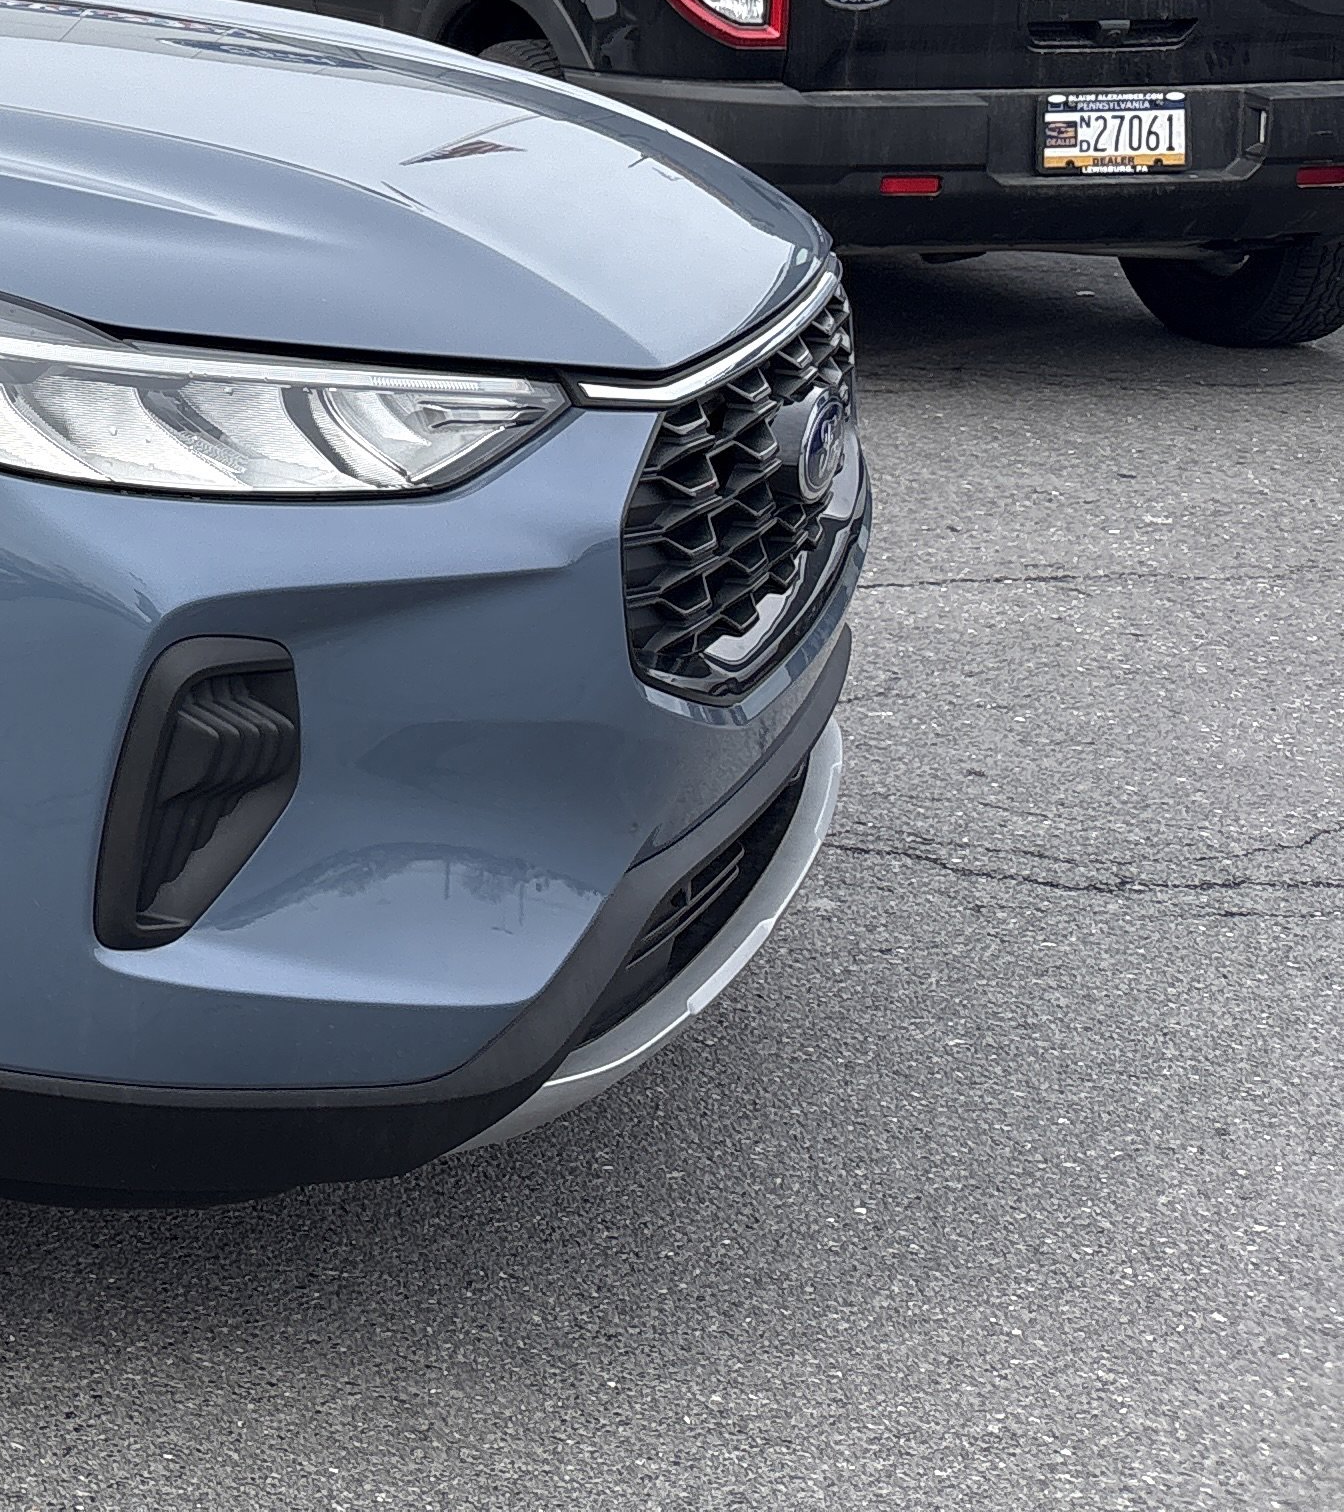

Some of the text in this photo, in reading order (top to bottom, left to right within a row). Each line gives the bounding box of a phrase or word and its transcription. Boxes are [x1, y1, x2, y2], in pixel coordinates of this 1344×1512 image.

[1076, 100, 1151, 111] PENNSYLVANIA
[1093, 114, 1176, 152] 27061
[1091, 156, 1136, 166] DEALER
